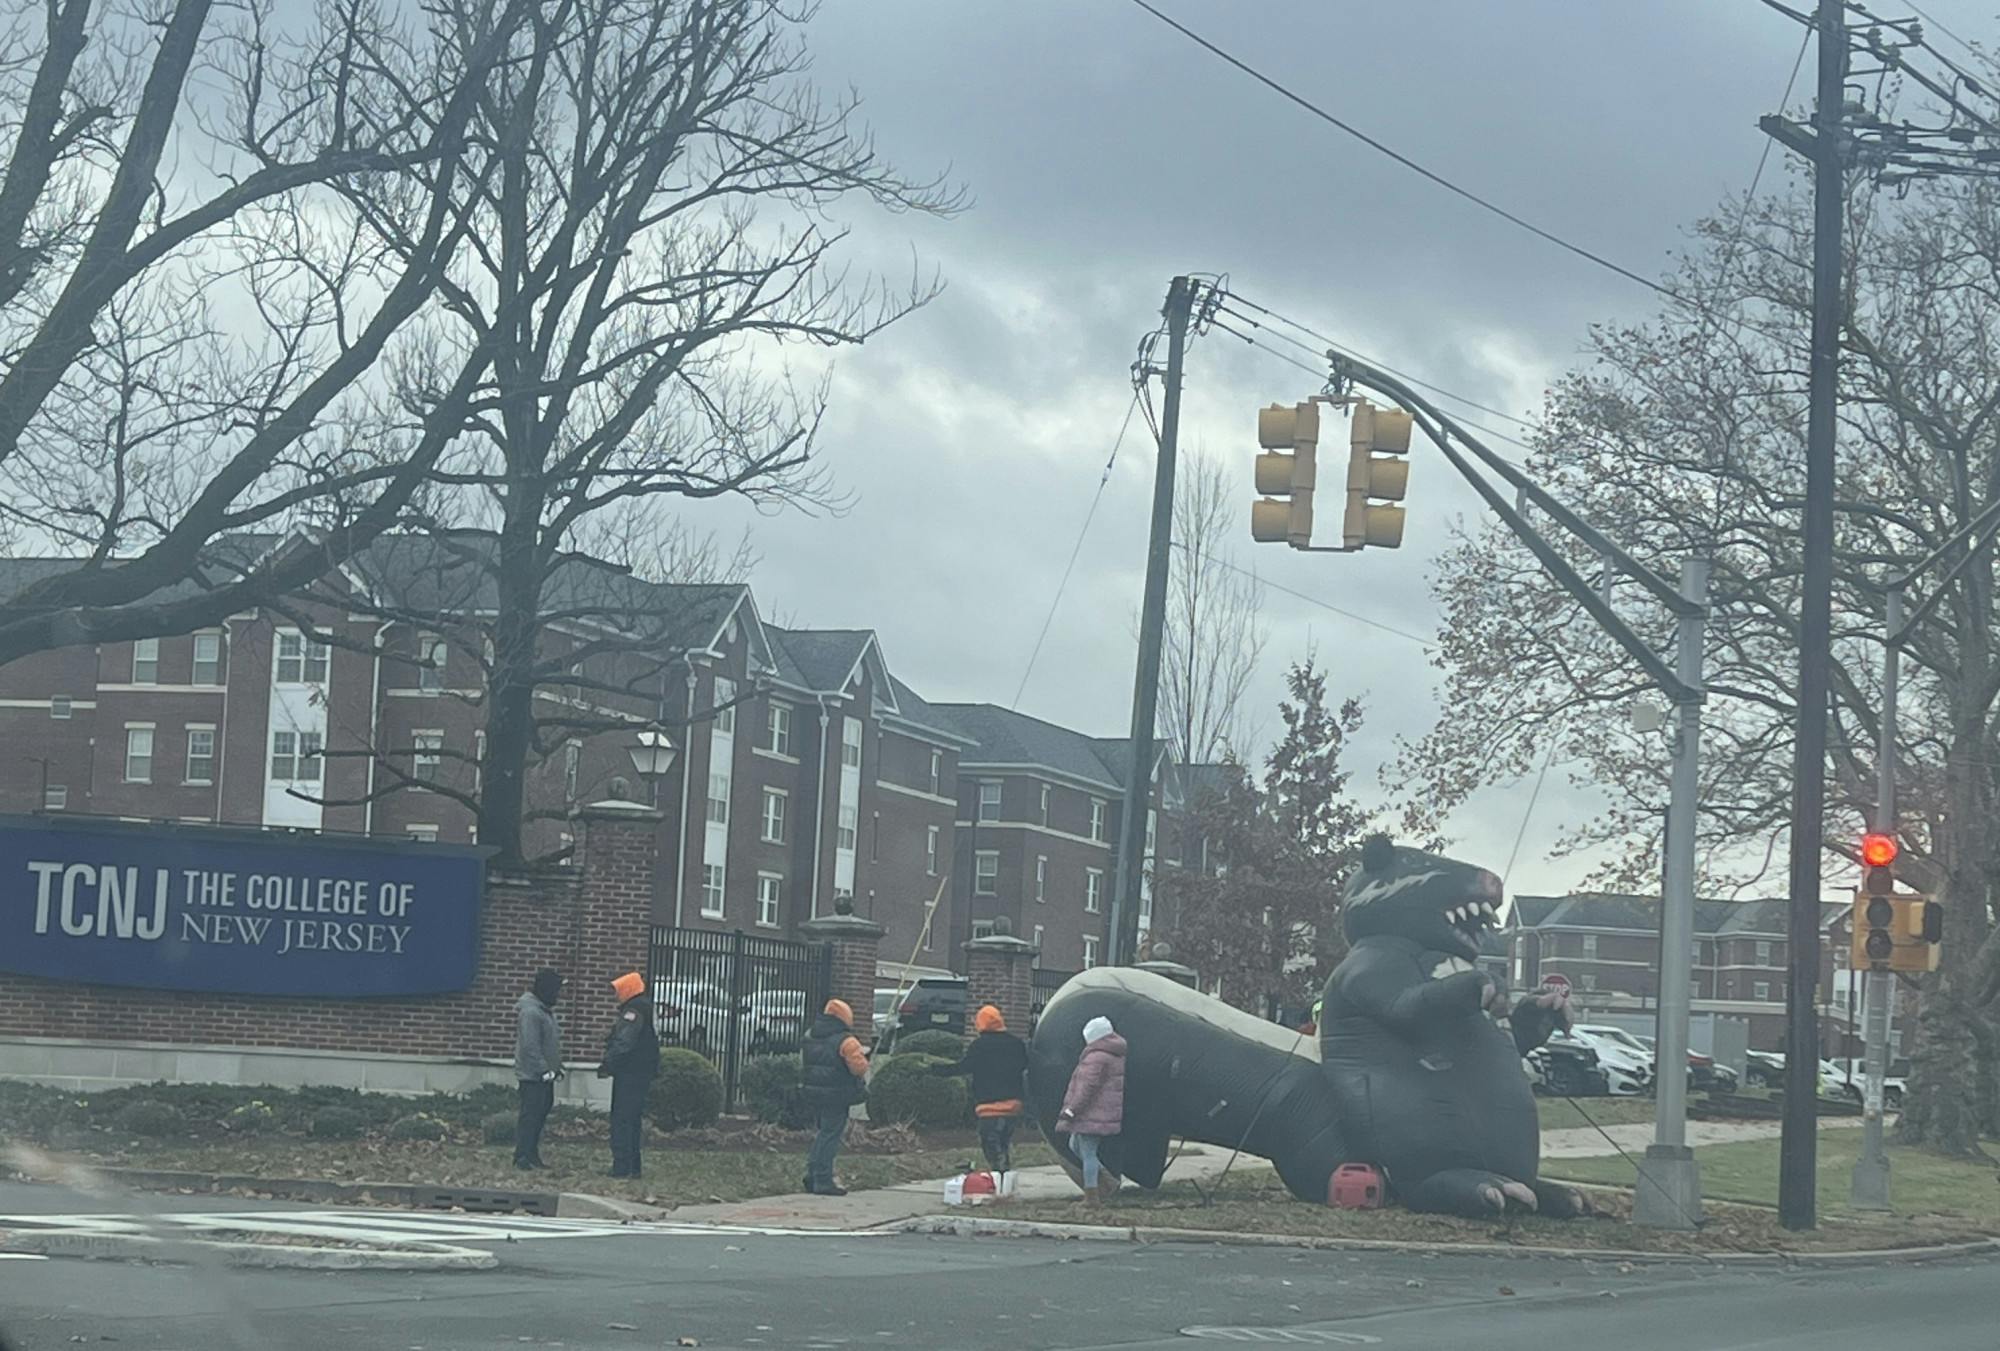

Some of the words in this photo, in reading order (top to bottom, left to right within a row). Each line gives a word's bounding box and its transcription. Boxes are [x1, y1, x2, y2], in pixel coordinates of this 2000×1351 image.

[27, 861, 169, 940] TCNJ
[183, 870, 237, 907] THE
[247, 874, 369, 915] COLLEGE
[379, 882, 414, 917] OF
[180, 912, 272, 945] NEW
[277, 918, 412, 954] JERSEY
